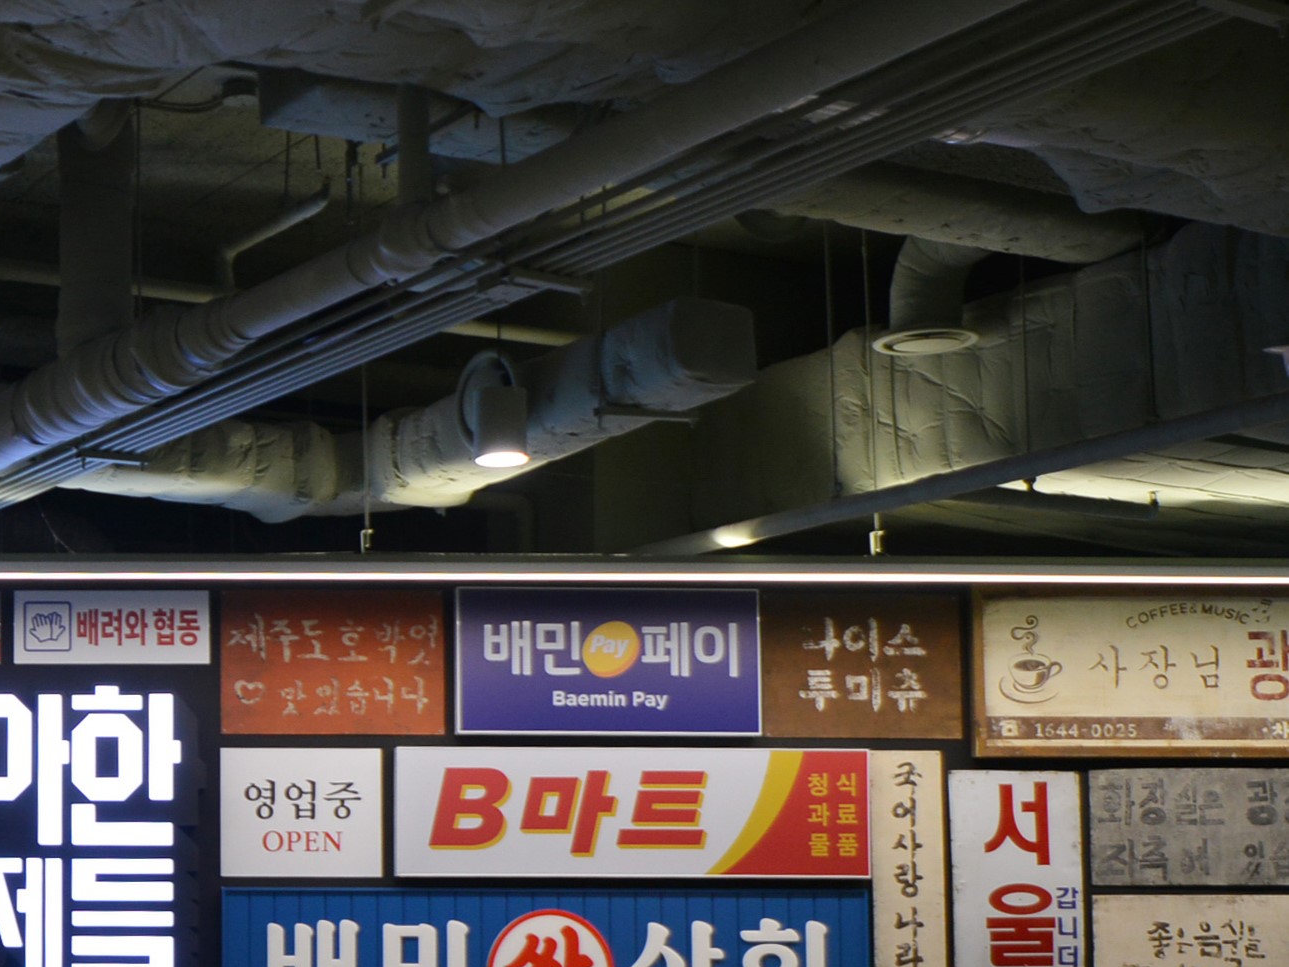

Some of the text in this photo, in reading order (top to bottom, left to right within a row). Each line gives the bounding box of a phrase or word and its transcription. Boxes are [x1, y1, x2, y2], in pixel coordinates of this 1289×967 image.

[76, 606, 201, 647] 배려와 협동
[589, 634, 630, 658] Pay
[483, 620, 740, 678] 배민 페이
[1088, 644, 1222, 690] 사장님
[552, 691, 669, 711] Baemin Pay
[1033, 722, 1138, 738] 1644-0025
[244, 779, 361, 820] 영업중
[428, 767, 708, 857] B마트
[262, 830, 342, 852] OPEN
[983, 781, 1056, 967] 서울
